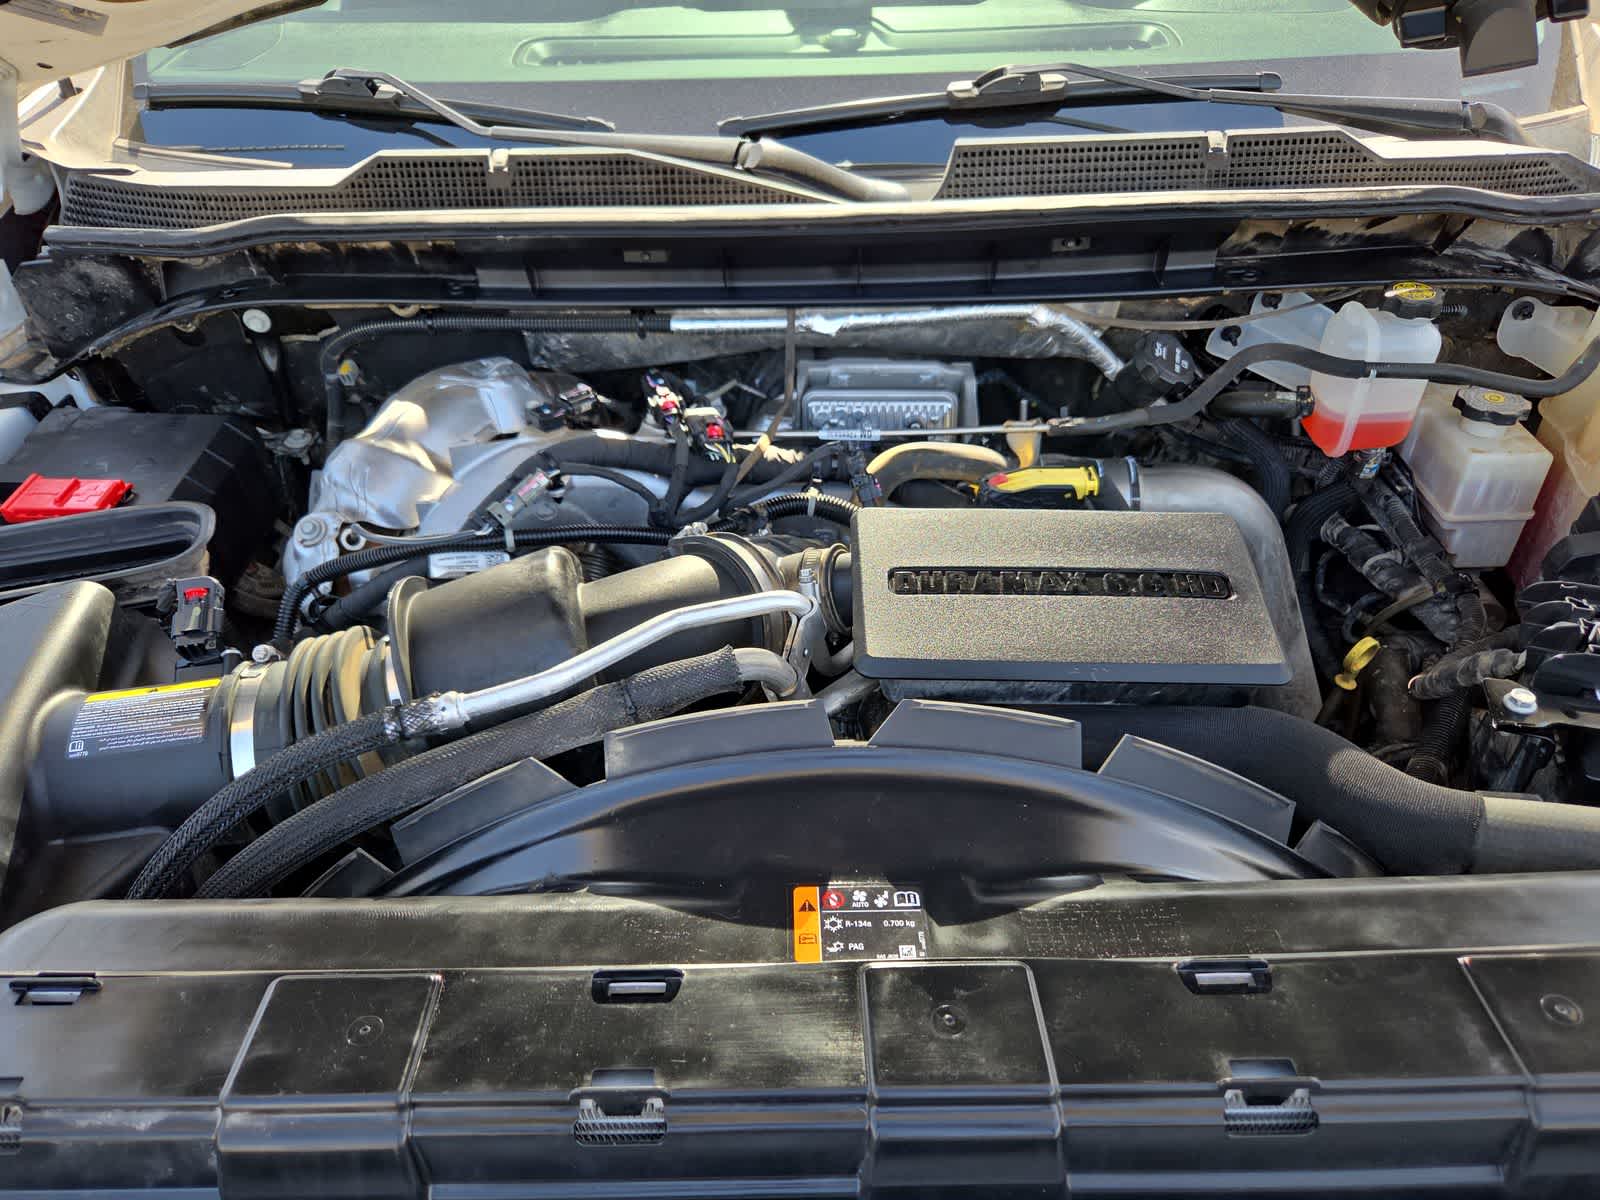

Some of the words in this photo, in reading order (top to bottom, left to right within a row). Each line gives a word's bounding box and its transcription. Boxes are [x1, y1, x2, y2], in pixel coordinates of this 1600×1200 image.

[892, 568, 1090, 596] DURAMAX
[1171, 572, 1229, 598] HD
[845, 920, 872, 928] R-134a
[883, 919, 904, 928] 0.700
[905, 919, 916, 928] kg
[848, 942, 865, 951] PAG
